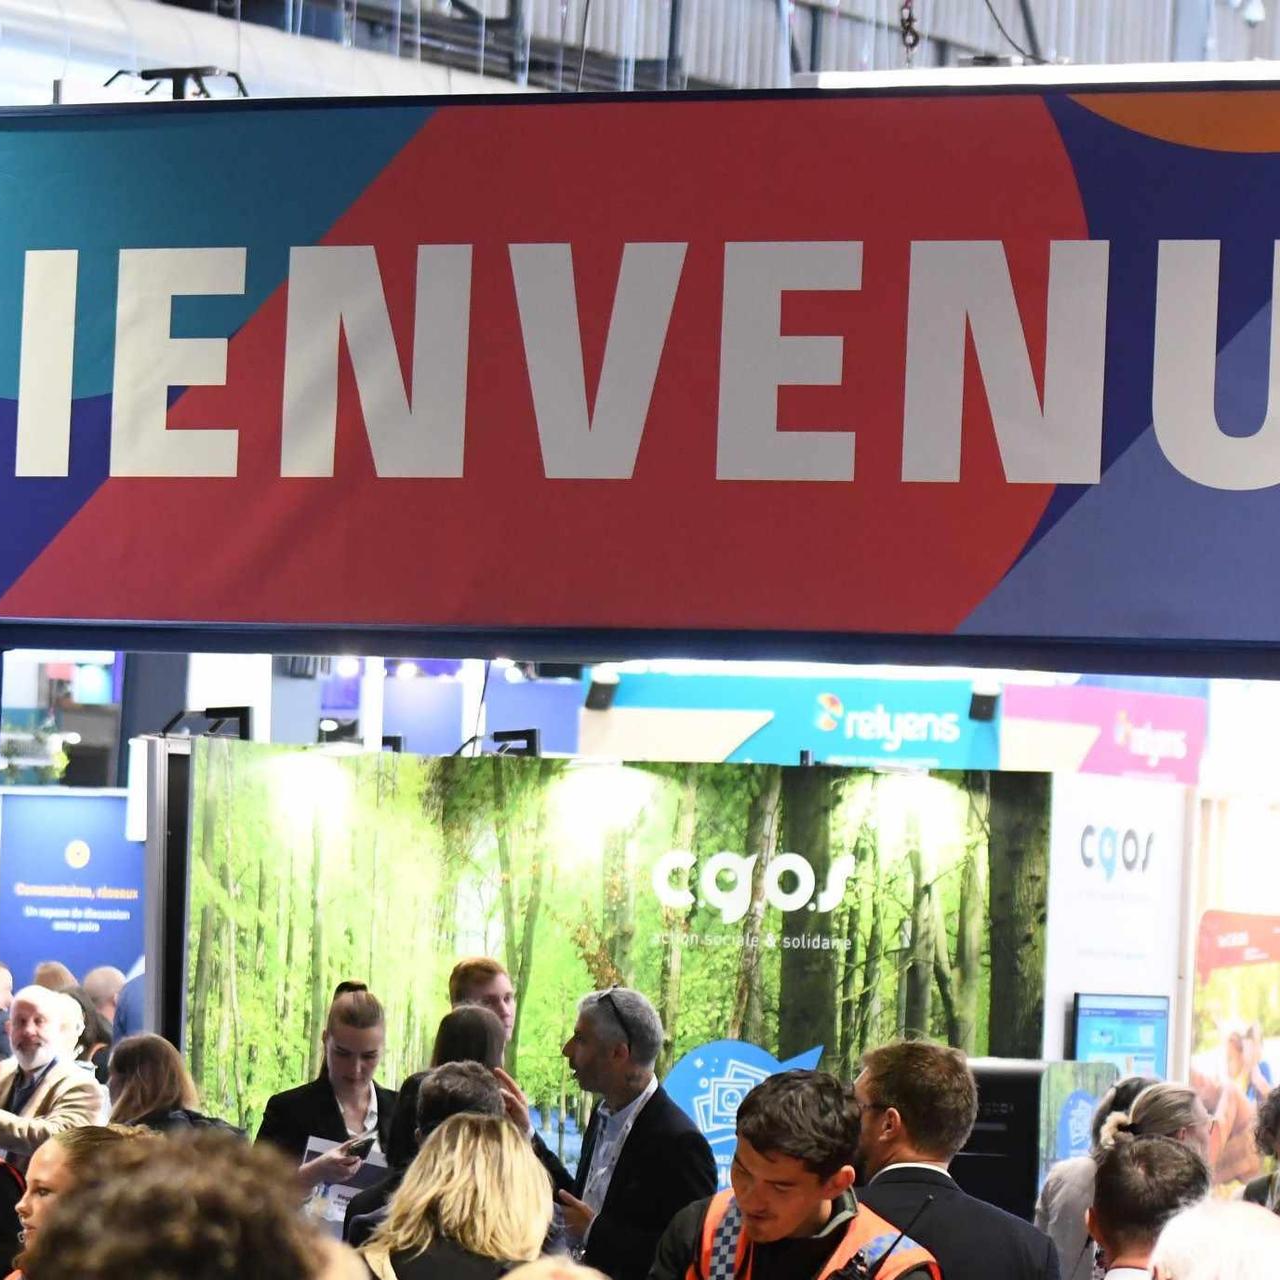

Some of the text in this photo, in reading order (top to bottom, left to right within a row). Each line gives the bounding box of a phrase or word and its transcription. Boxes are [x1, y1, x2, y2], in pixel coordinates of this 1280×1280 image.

[845, 704, 961, 752] relyens
[701, 932, 759, 948] sociale
[782, 934, 852, 951] solidaire
